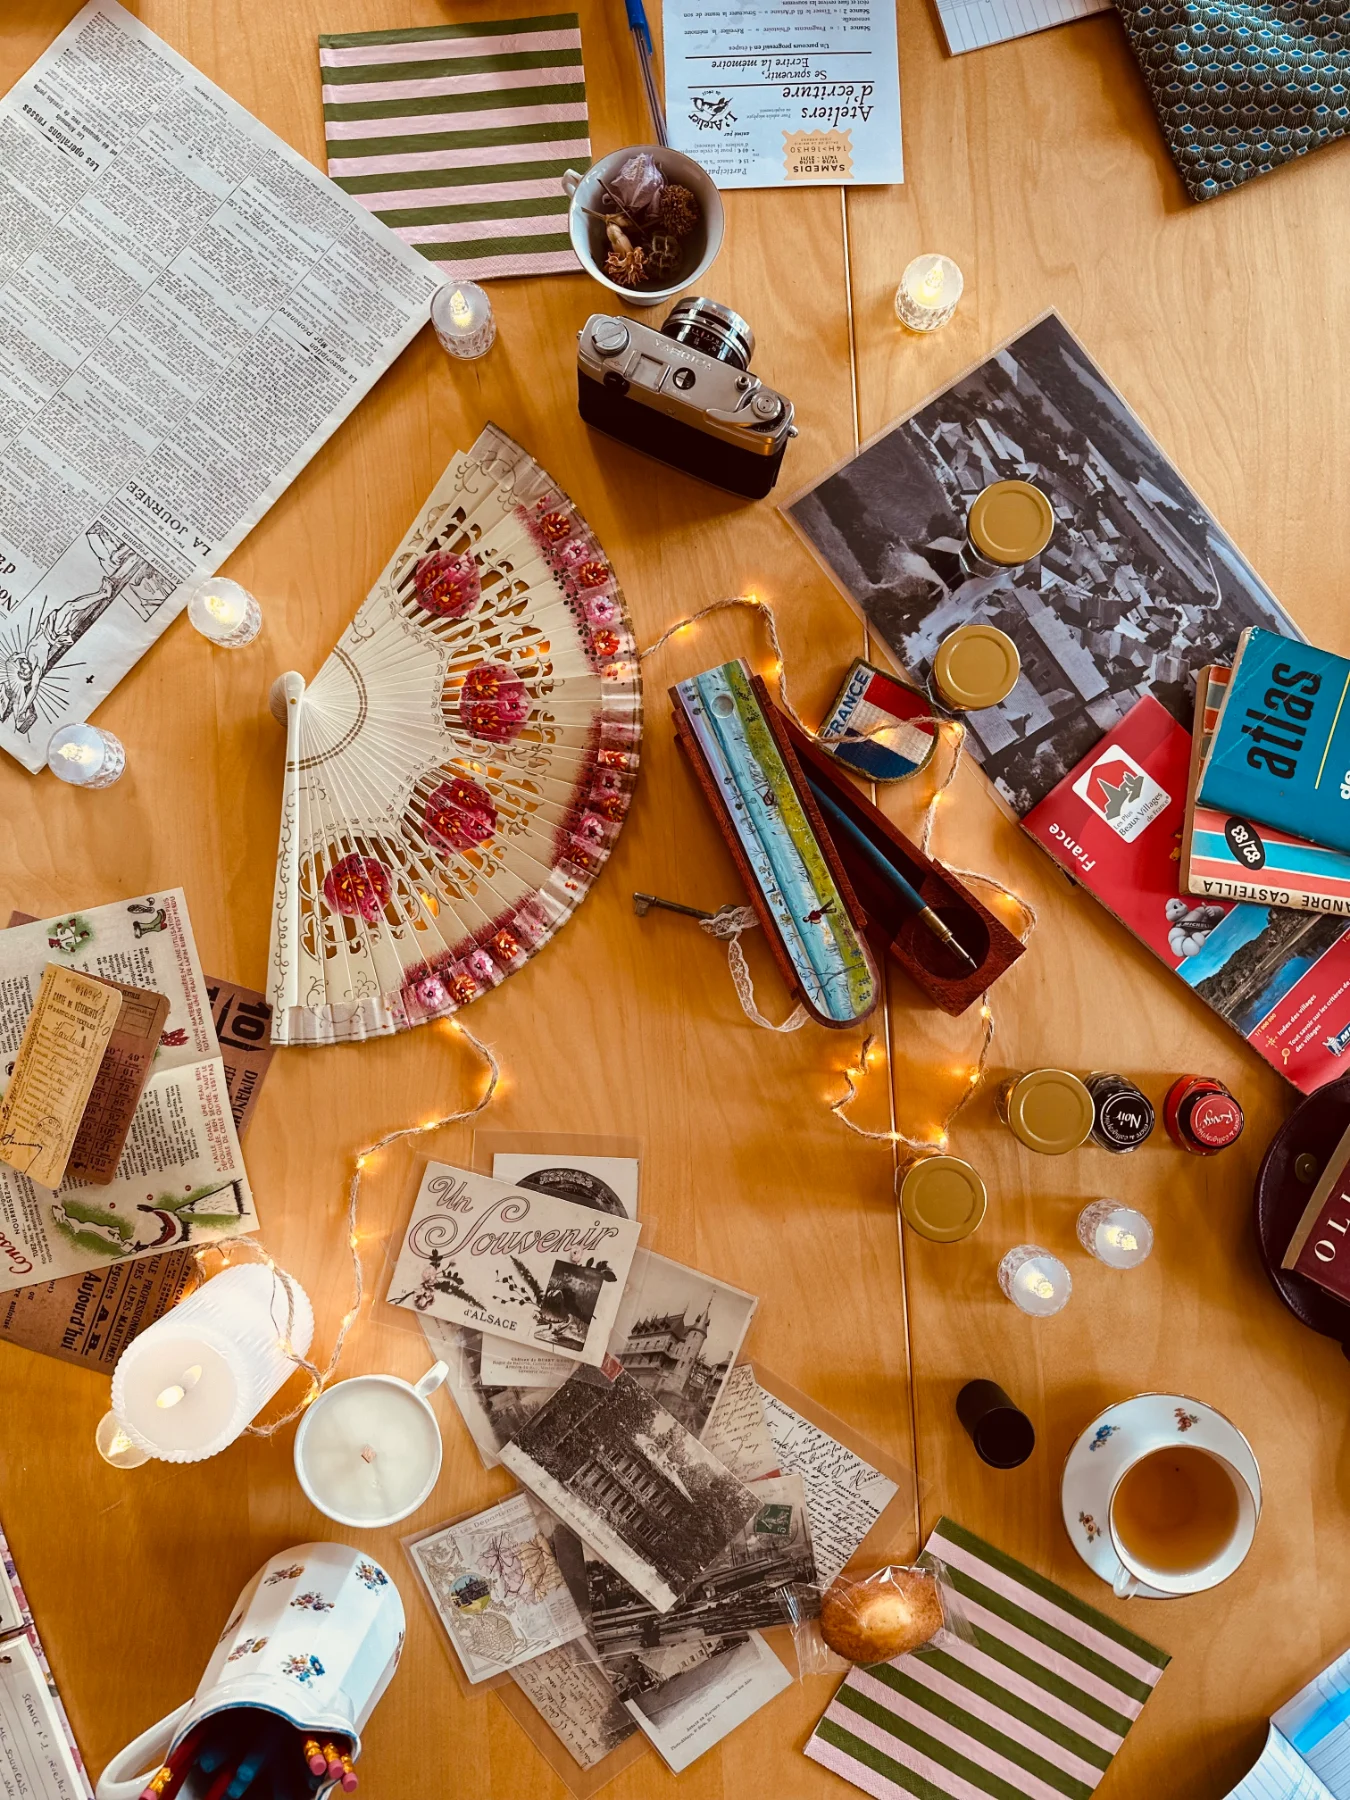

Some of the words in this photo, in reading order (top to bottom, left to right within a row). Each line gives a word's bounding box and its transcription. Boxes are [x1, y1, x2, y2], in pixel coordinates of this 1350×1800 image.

[793, 41, 818, 49] parcours
[711, 59, 757, 72] mémoire
[760, 58, 771, 70] la
[761, 69, 810, 80] souvenir,
[814, 69, 826, 79] Se
[782, 83, 872, 104] d'écriture
[21, 103, 47, 126] russes
[687, 110, 738, 131] L'Atelier
[800, 103, 874, 127] Ateliers
[47, 125, 84, 157] opérations
[789, 144, 846, 152] 14H>16H30
[84, 156, 100, 172] Les
[703, 165, 746, 175] Participat
[792, 164, 844, 172] SAMEDIS
[313, 336, 328, 349] Mgr
[308, 342, 348, 375] souscription
[327, 348, 346, 362] pour
[347, 373, 358, 383] La
[126, 480, 188, 534] JOURNÉE
[99, 513, 119, 531] tuum
[121, 531, 149, 556] regnum
[192, 536, 211, 556] LA
[150, 557, 185, 585] Adveniat
[1246, 661, 1320, 780] atlas
[1112, 820, 1123, 830] Les
[1120, 810, 1133, 822] Plus
[1118, 816, 1140, 836] Beaux
[1136, 792, 1163, 816] Villages
[1146, 813, 1154, 822] de
[1048, 823, 1095, 871] France
[1230, 825, 1260, 863] 82/83
[1203, 880, 1289, 904] CASTEILLA
[162, 896, 171, 913] PLUS
[169, 895, 178, 915] PERDU
[166, 912, 179, 948] UTILISATION
[173, 915, 182, 933] N'EST
[174, 948, 183, 962] UNE
[181, 948, 191, 967] LAPIN
[177, 961, 185, 974] N'A
[185, 967, 193, 976] DE
[188, 976, 196, 993] PEAU
[191, 993, 200, 1006] UNE
[195, 1006, 204, 1025] DANS
[231, 1001, 270, 1040] 10
[1276, 1020, 1292, 1036] Index
[1289, 1012, 1300, 1022] des
[1297, 994, 1316, 1013] villages
[1287, 1033, 1301, 1046] Tout
[1298, 1019, 1313, 1036] savoir
[1311, 1011, 1321, 1021] sur
[1318, 1004, 1328, 1013] les
[1326, 987, 1344, 1006] critères
[1342, 980, 1350, 989] de
[75, 1016, 96, 1030] TEXTILES
[192, 1027, 203, 1052] AUCUNE
[1294, 1042, 1305, 1052] des
[1302, 1023, 1321, 1043] villages
[194, 1066, 202, 1081] BIEN
[200, 1064, 207, 1072] LE
[201, 1074, 209, 1090] VAUT
[209, 1077, 217, 1092] L'EST
[212, 1093, 218, 1103] NE
[231, 1069, 258, 1129] DIMANCH
[200, 1104, 208, 1117] UNE
[214, 1103, 222, 1116] QUI
[1116, 1109, 1142, 1129] Noir
[211, 1117, 219, 1132] BIEN
[217, 1117, 226, 1134] CELLE
[221, 1134, 229, 1144] DE
[175, 1147, 185, 1167] VENDEZ
[209, 1144, 219, 1164] TAILLE
[223, 1145, 235, 1169] DOUBLE
[426, 1173, 475, 1214] Un
[408, 1195, 620, 1258] Souvenir
[133, 1262, 146, 1280] DES
[60, 1271, 101, 1352] Aujourd'hui
[463, 1307, 518, 1333] d'ALSACE
[104, 1283, 136, 1364] ALPES-MARITIMES
[4, 1748, 28, 1795] SOUVIENS
